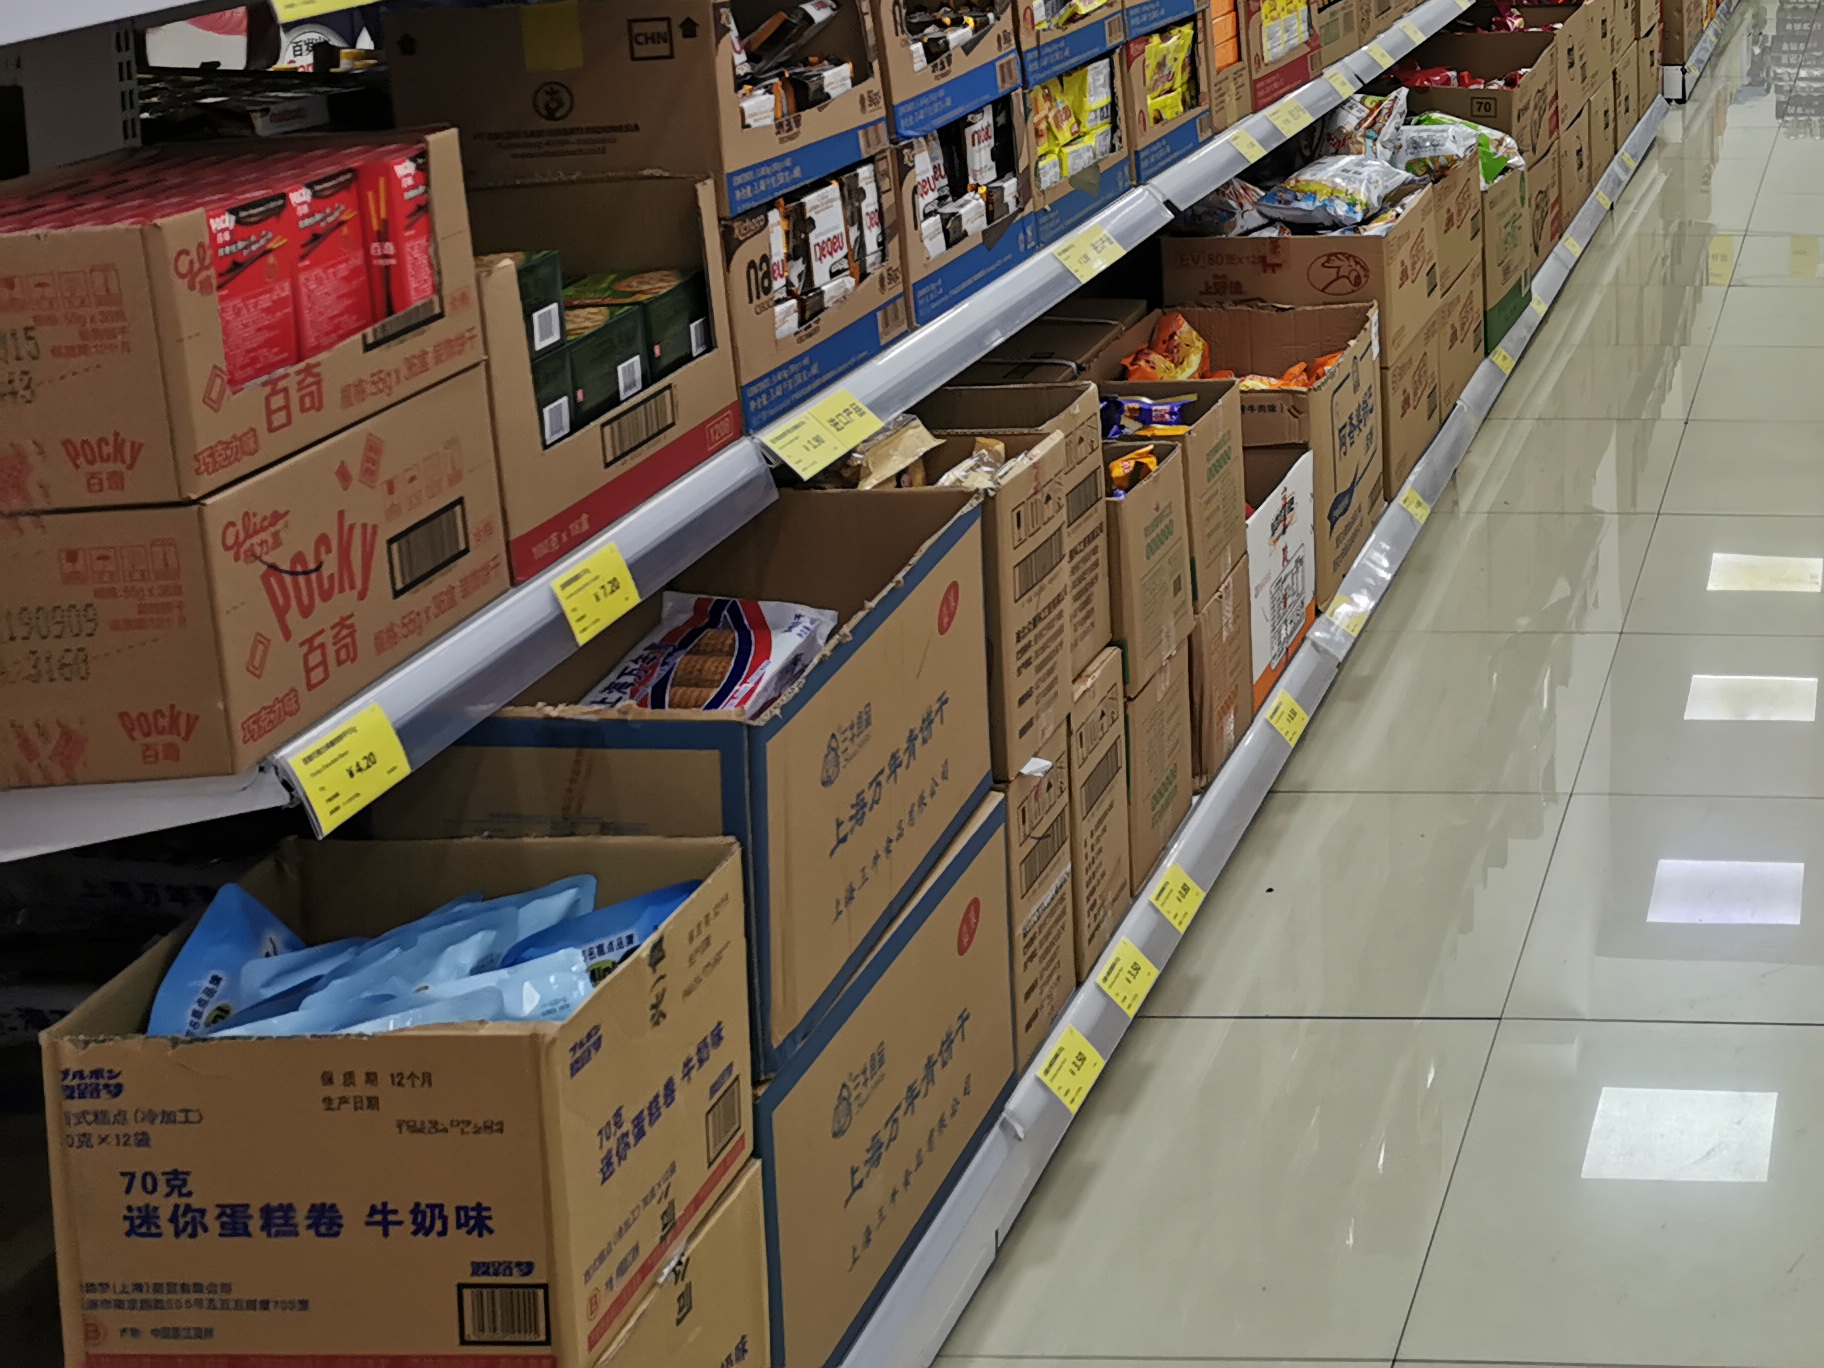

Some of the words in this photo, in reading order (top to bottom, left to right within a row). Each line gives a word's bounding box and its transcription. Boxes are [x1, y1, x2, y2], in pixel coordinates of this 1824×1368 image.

[634, 32, 669, 47] CHN
[263, 361, 324, 433] 百奇
[61, 430, 144, 470] Pocky
[260, 508, 379, 642] Pocky
[299, 613, 358, 692] 百奇
[117, 703, 200, 741] Pocky
[119, 1168, 194, 1198] 70克
[122, 1202, 344, 1239] 迷你蛋糕卷
[365, 1201, 495, 1240] 牛奶味
